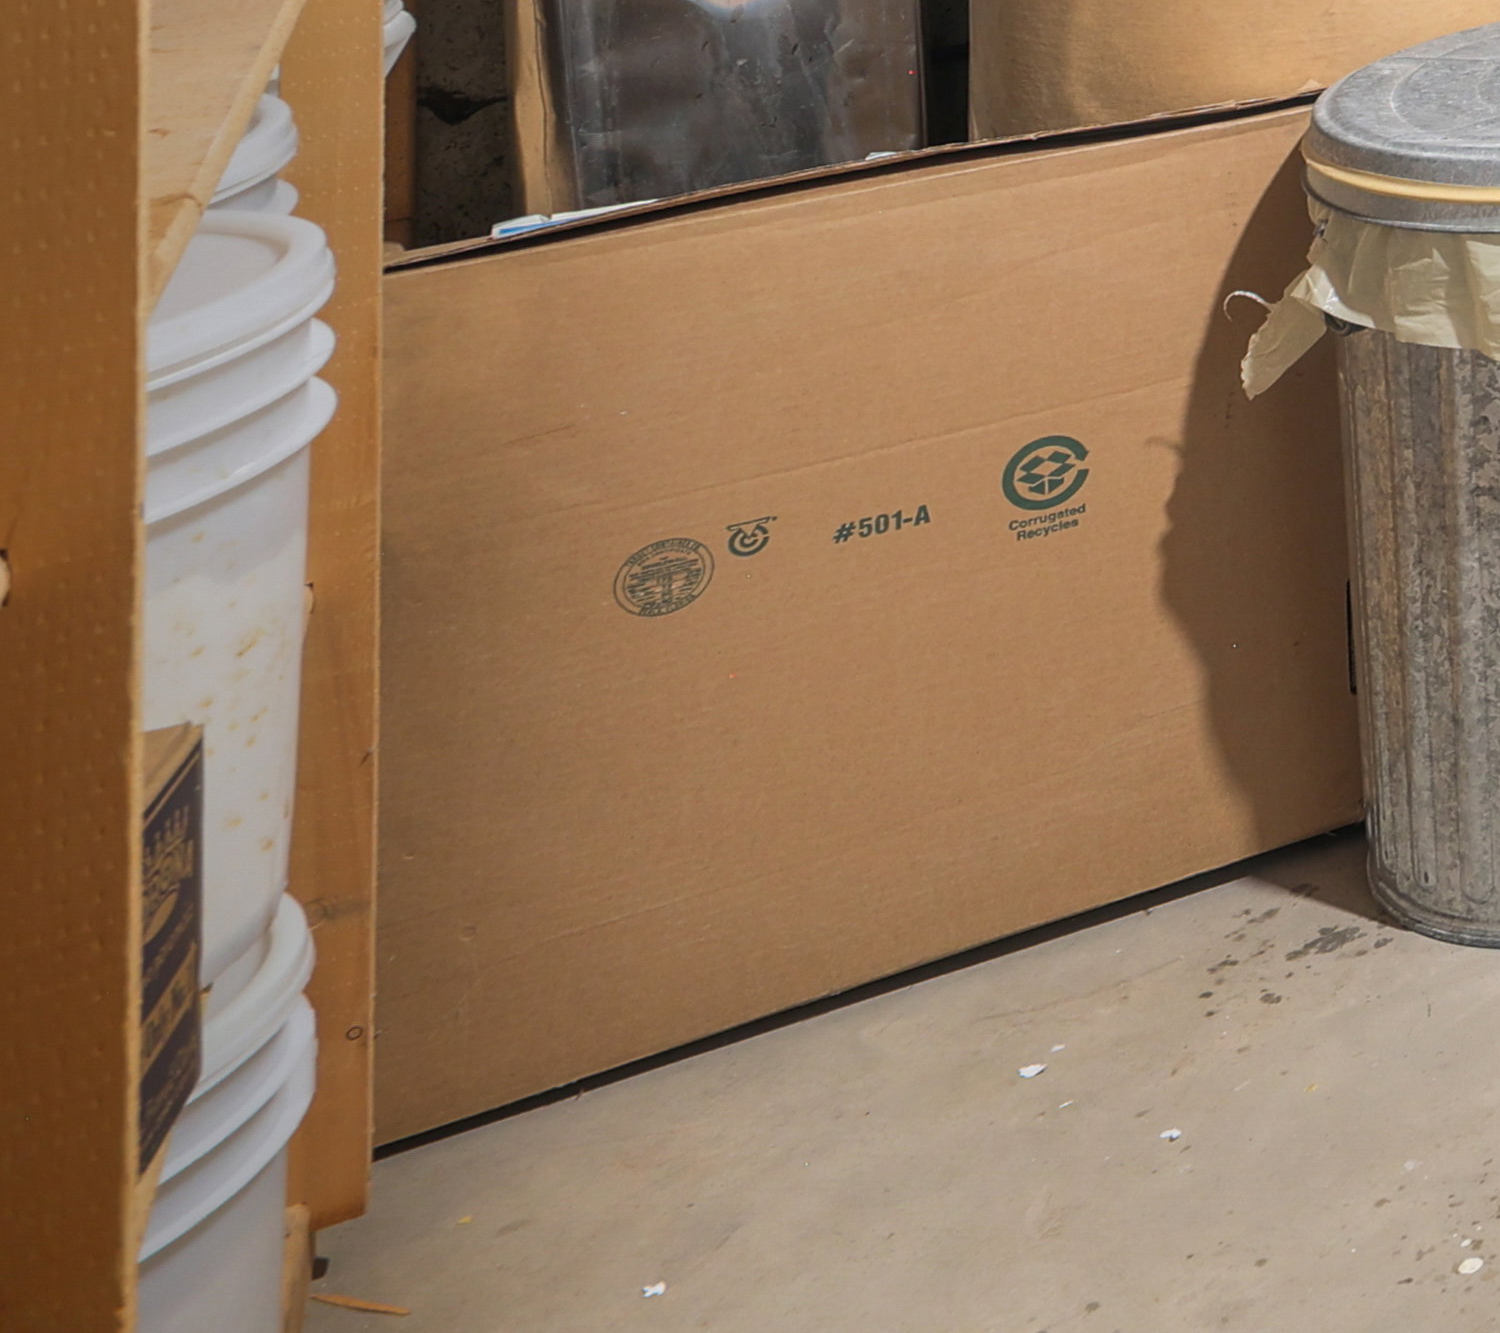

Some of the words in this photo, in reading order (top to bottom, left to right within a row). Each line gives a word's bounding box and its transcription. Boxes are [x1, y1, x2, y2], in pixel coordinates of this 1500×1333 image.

[833, 505, 931, 544] #501-A
[1008, 503, 1086, 532] Corrugated
[1016, 517, 1080, 541] Recycles
